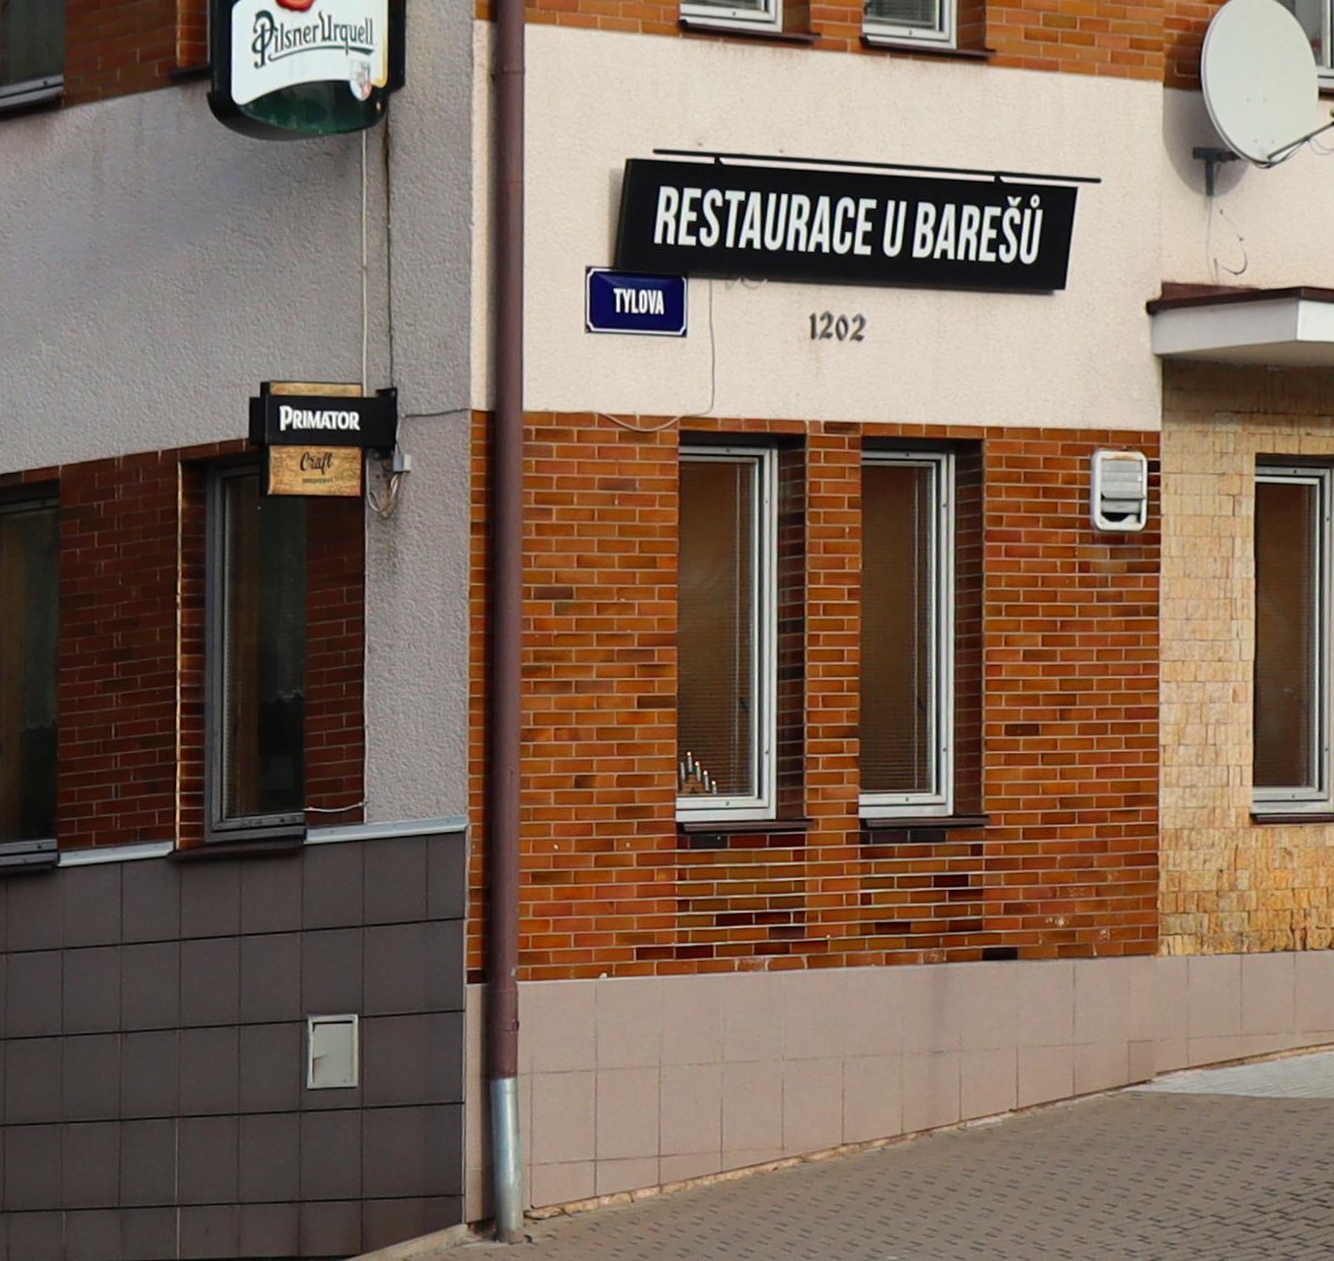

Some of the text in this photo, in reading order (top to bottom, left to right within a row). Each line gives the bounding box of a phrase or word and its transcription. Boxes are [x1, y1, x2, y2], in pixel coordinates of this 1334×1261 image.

[251, 10, 374, 69] Pilsner Urquell
[653, 186, 1043, 265] RESTAURACE U BAREŠŮ
[613, 288, 664, 315] TYLOVA
[809, 311, 867, 341] 1202
[279, 405, 360, 431] PRIMATOR
[300, 451, 333, 475] Craft
